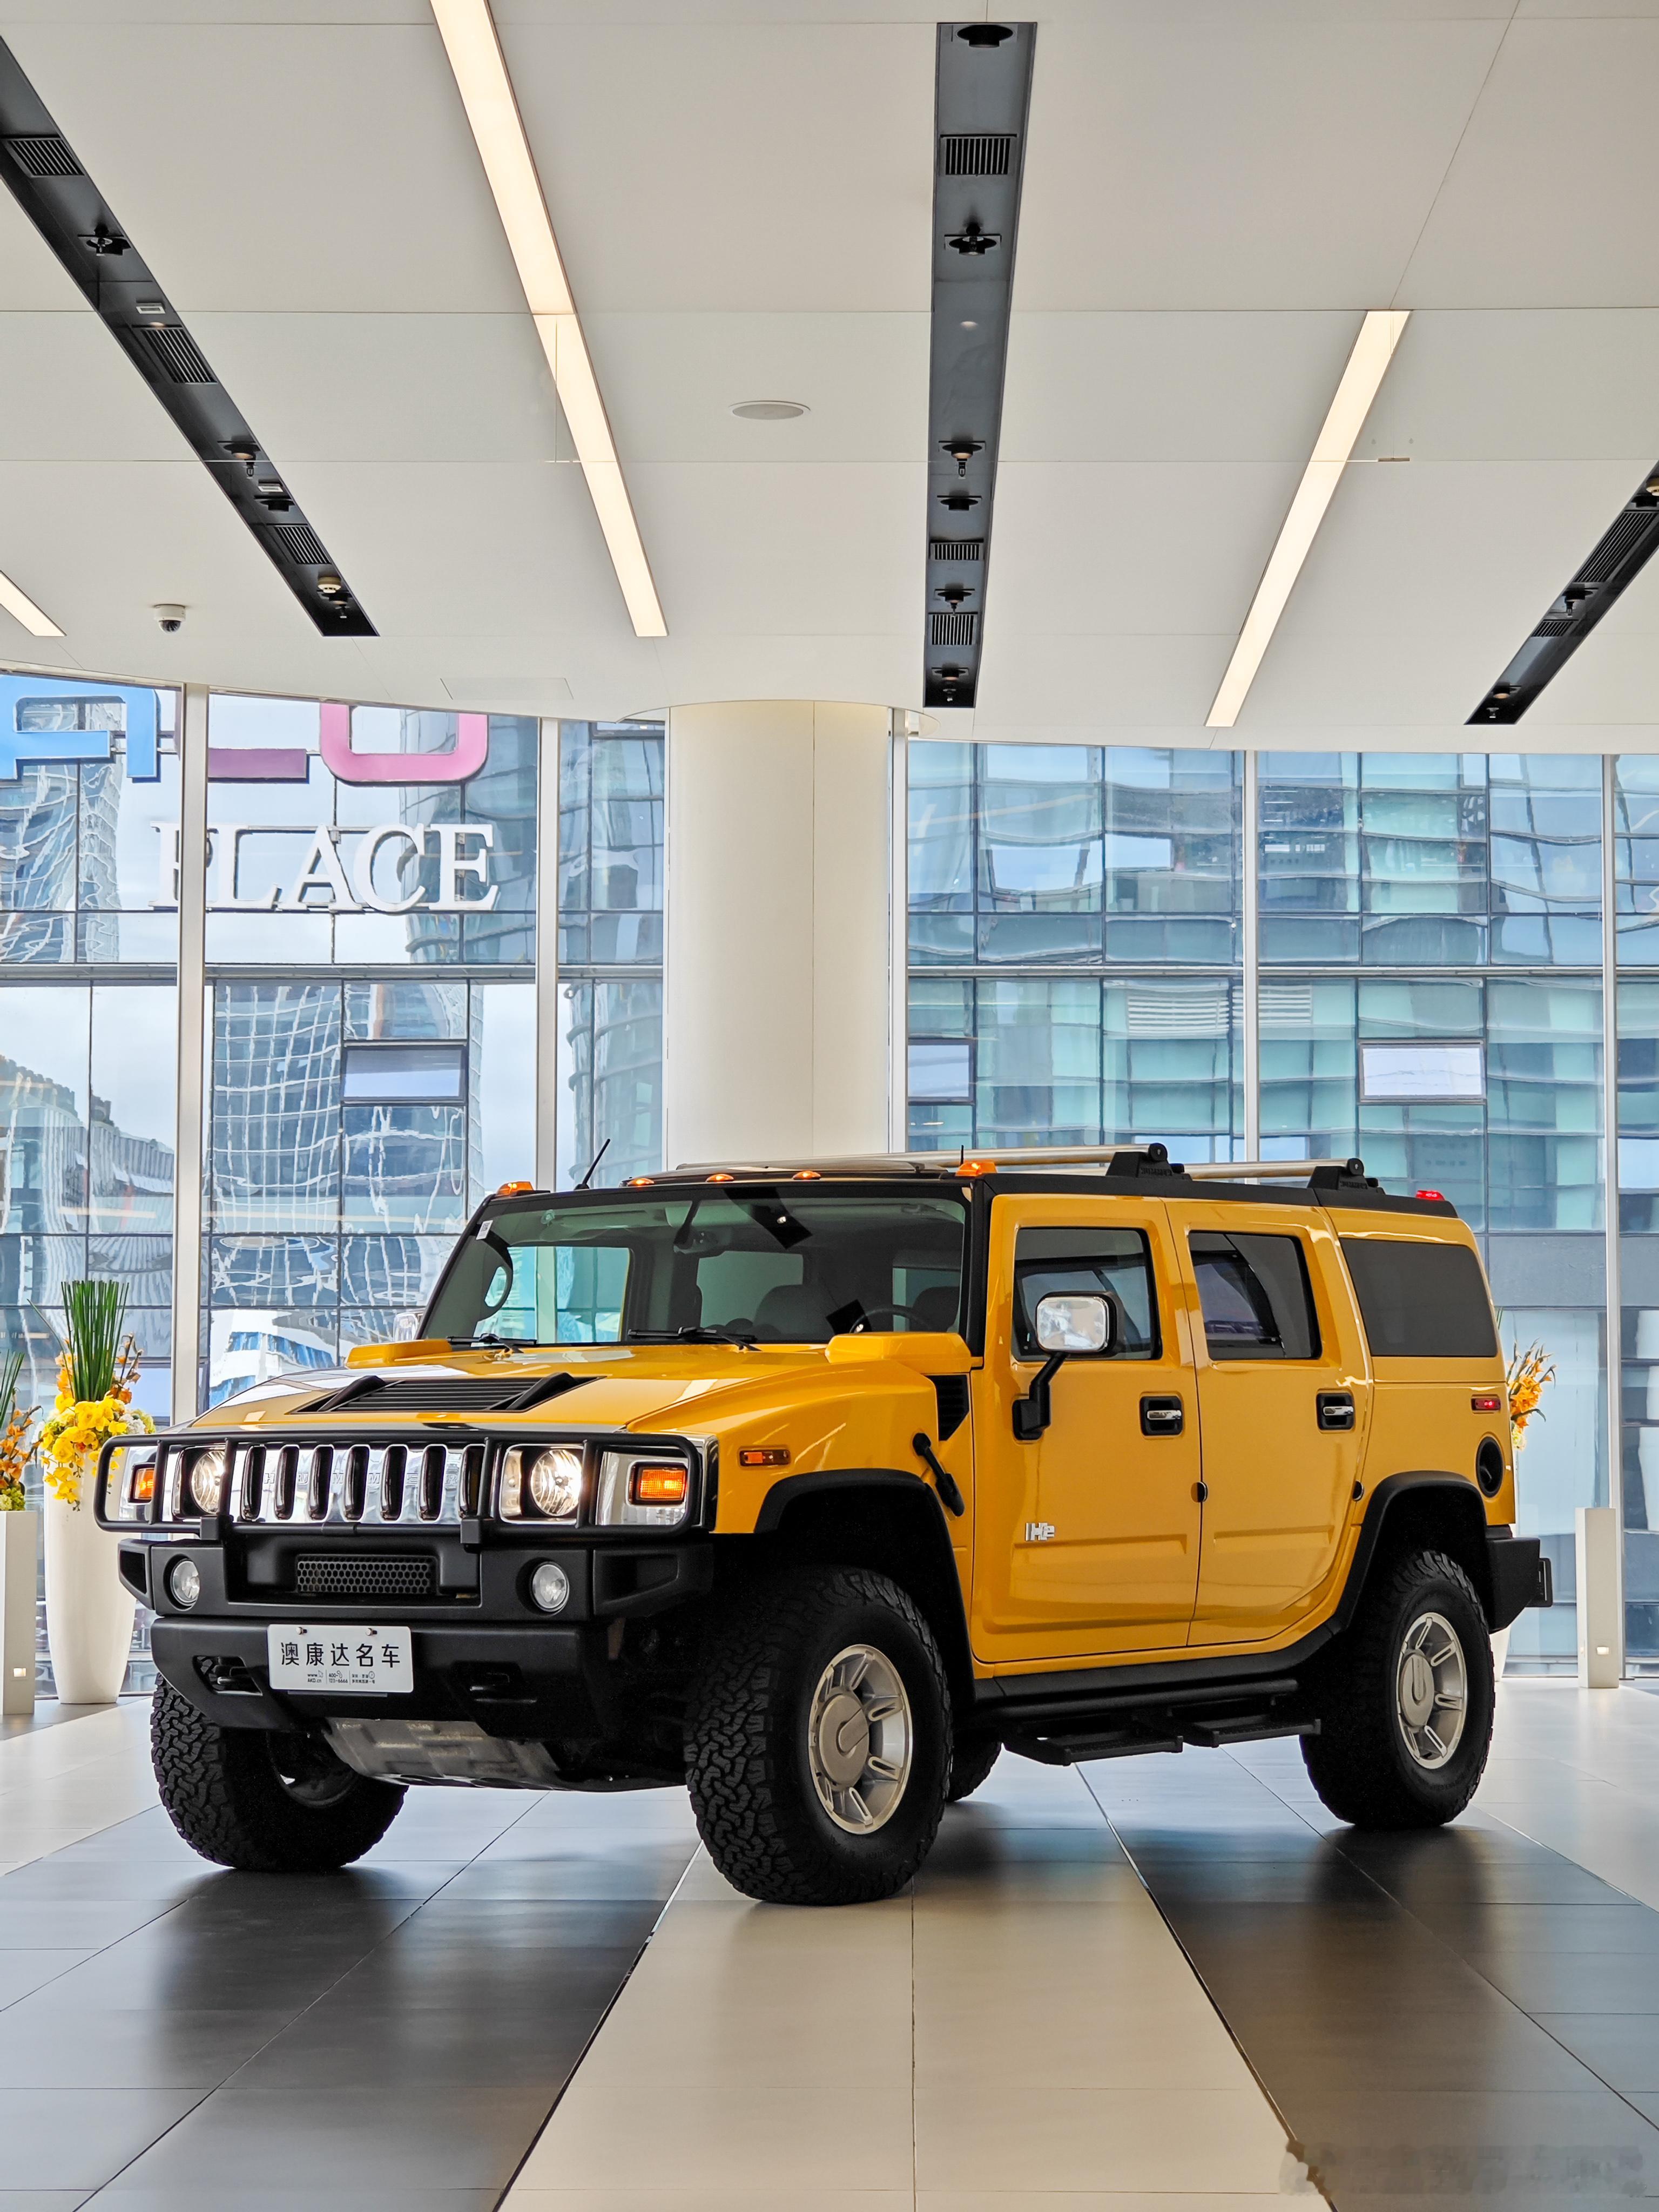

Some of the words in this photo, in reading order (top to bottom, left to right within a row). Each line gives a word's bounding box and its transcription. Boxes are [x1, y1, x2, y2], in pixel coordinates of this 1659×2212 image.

[281, 1642, 400, 1668] 澳康达名车
